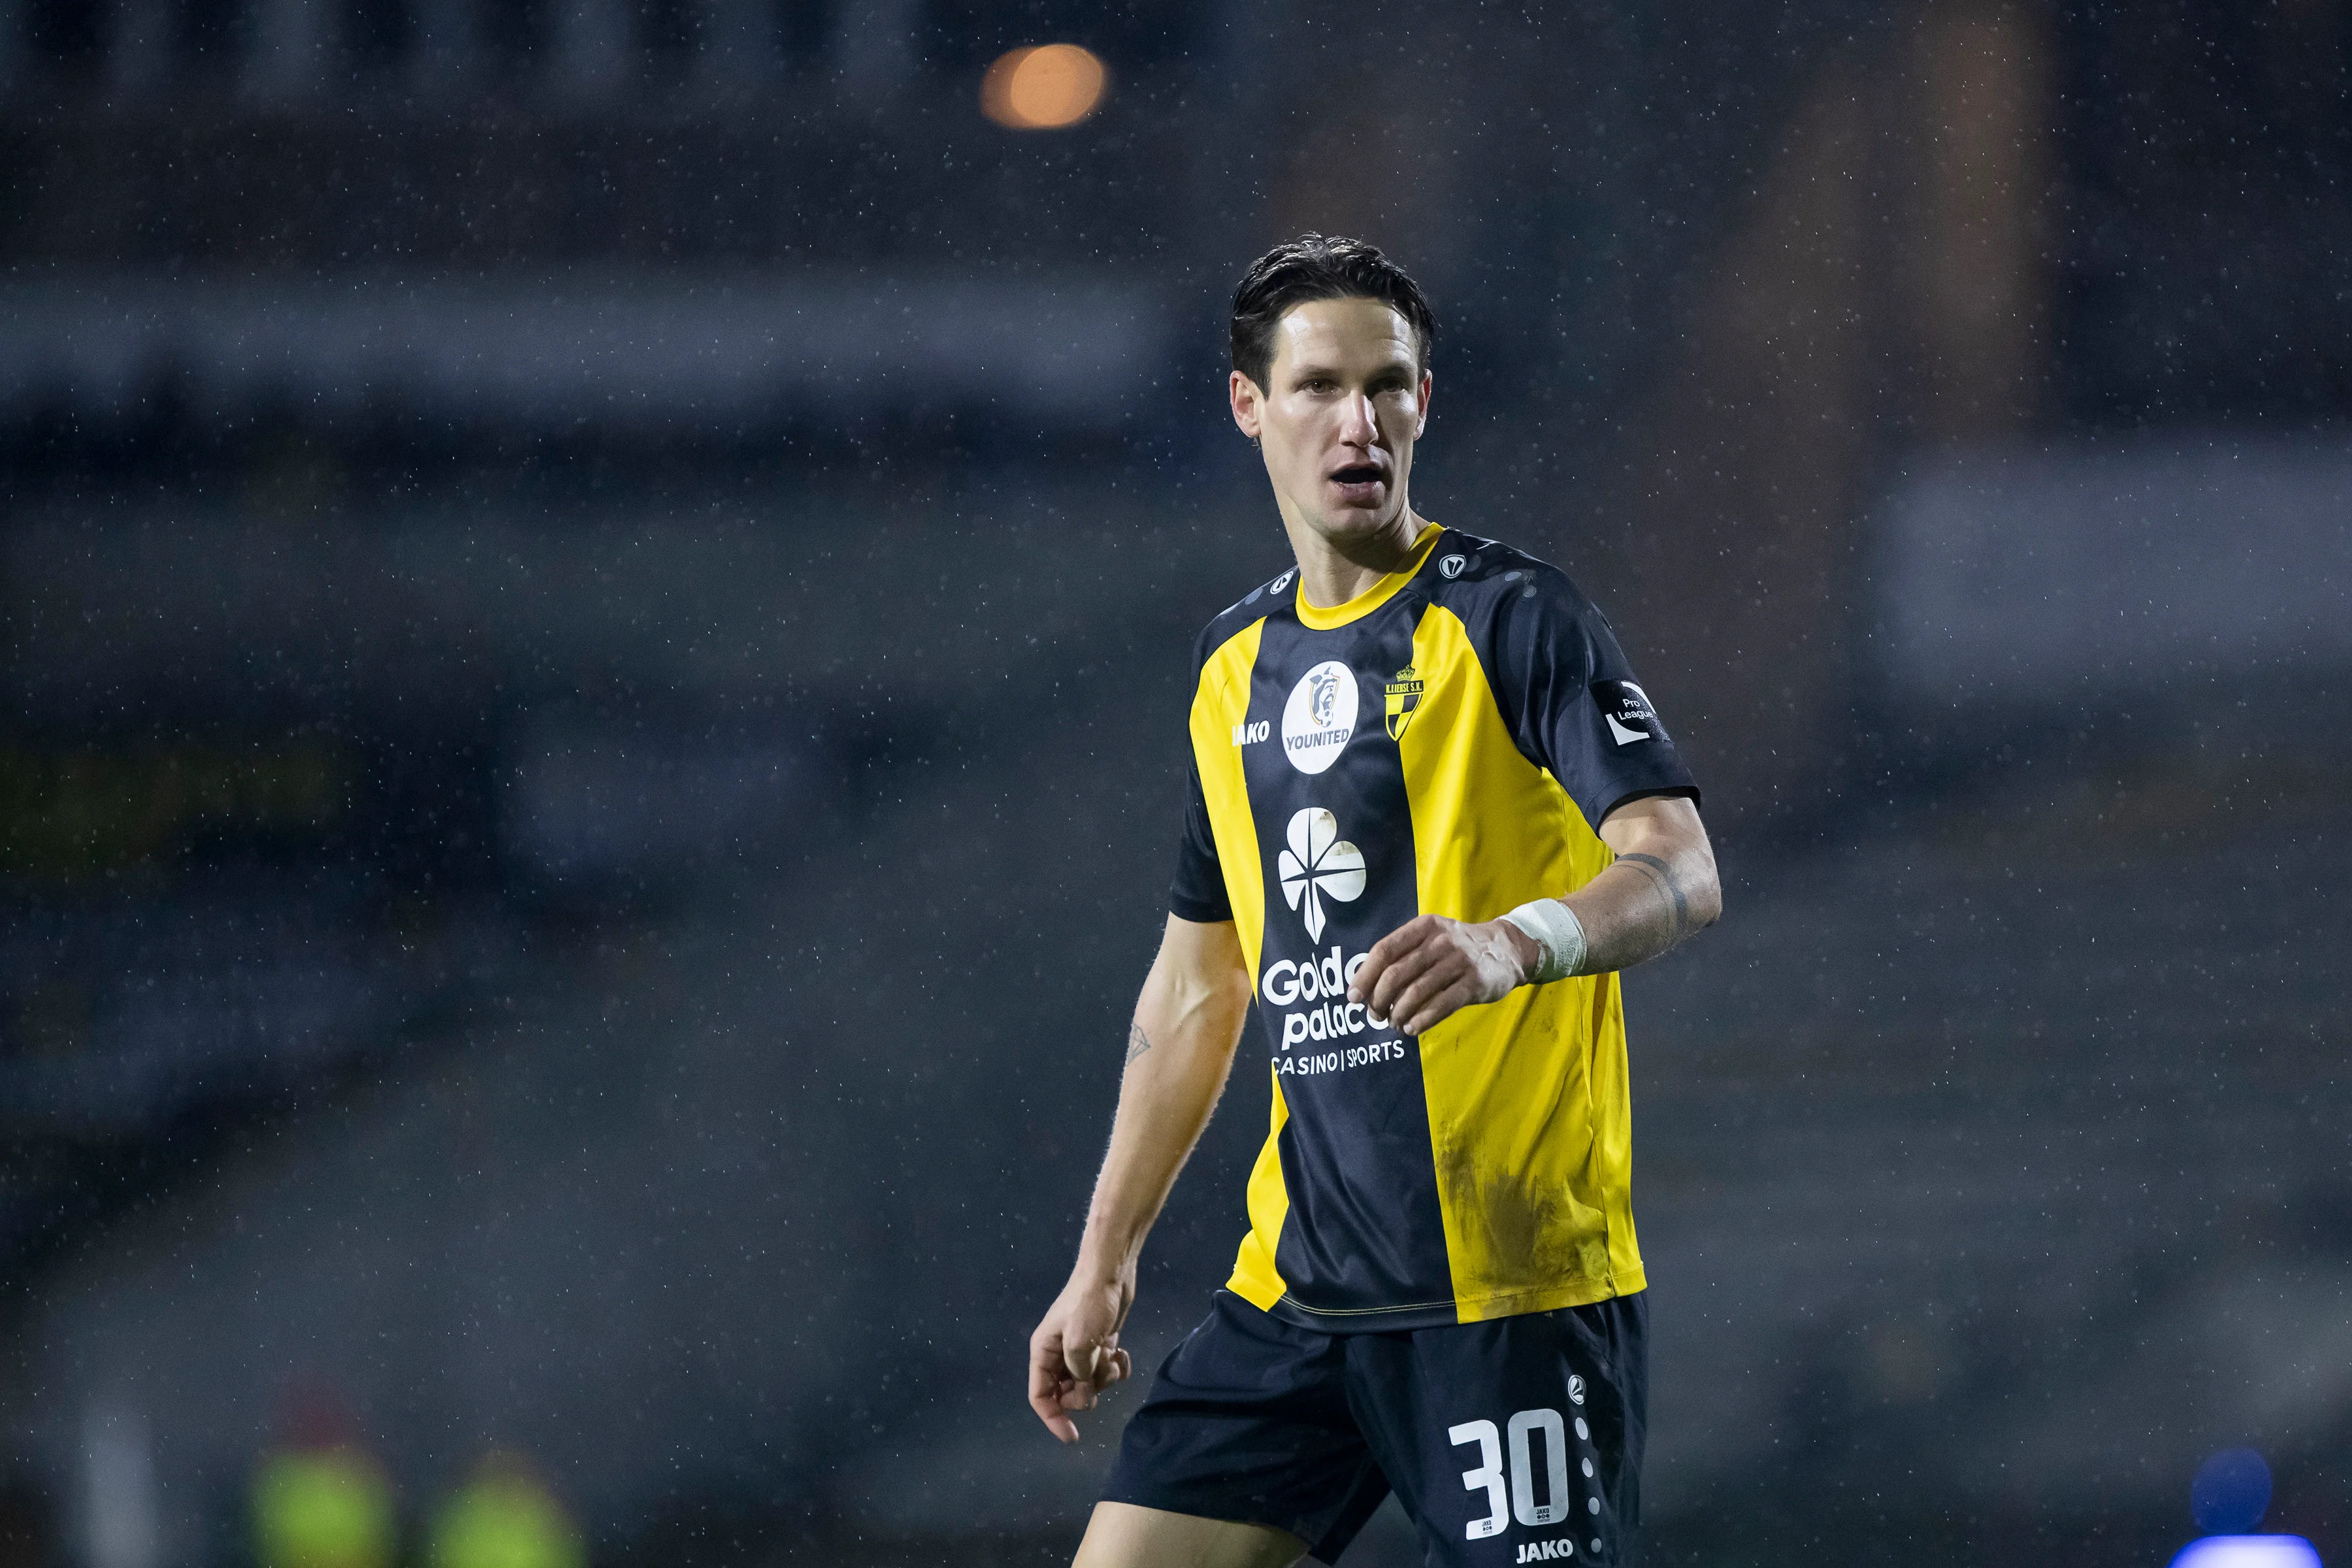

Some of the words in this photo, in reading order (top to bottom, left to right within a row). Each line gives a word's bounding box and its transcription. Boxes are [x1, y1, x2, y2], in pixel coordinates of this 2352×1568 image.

[1617, 710, 1654, 720] League
[1622, 698, 1641, 708] Pro
[1286, 728, 1349, 751] YOUNITED
[1262, 945, 1369, 1006] Gold
[1347, 1039, 1405, 1068] SPORTS
[1448, 1408, 1569, 1541] 30
[1516, 1539, 1573, 1564] JAKO
